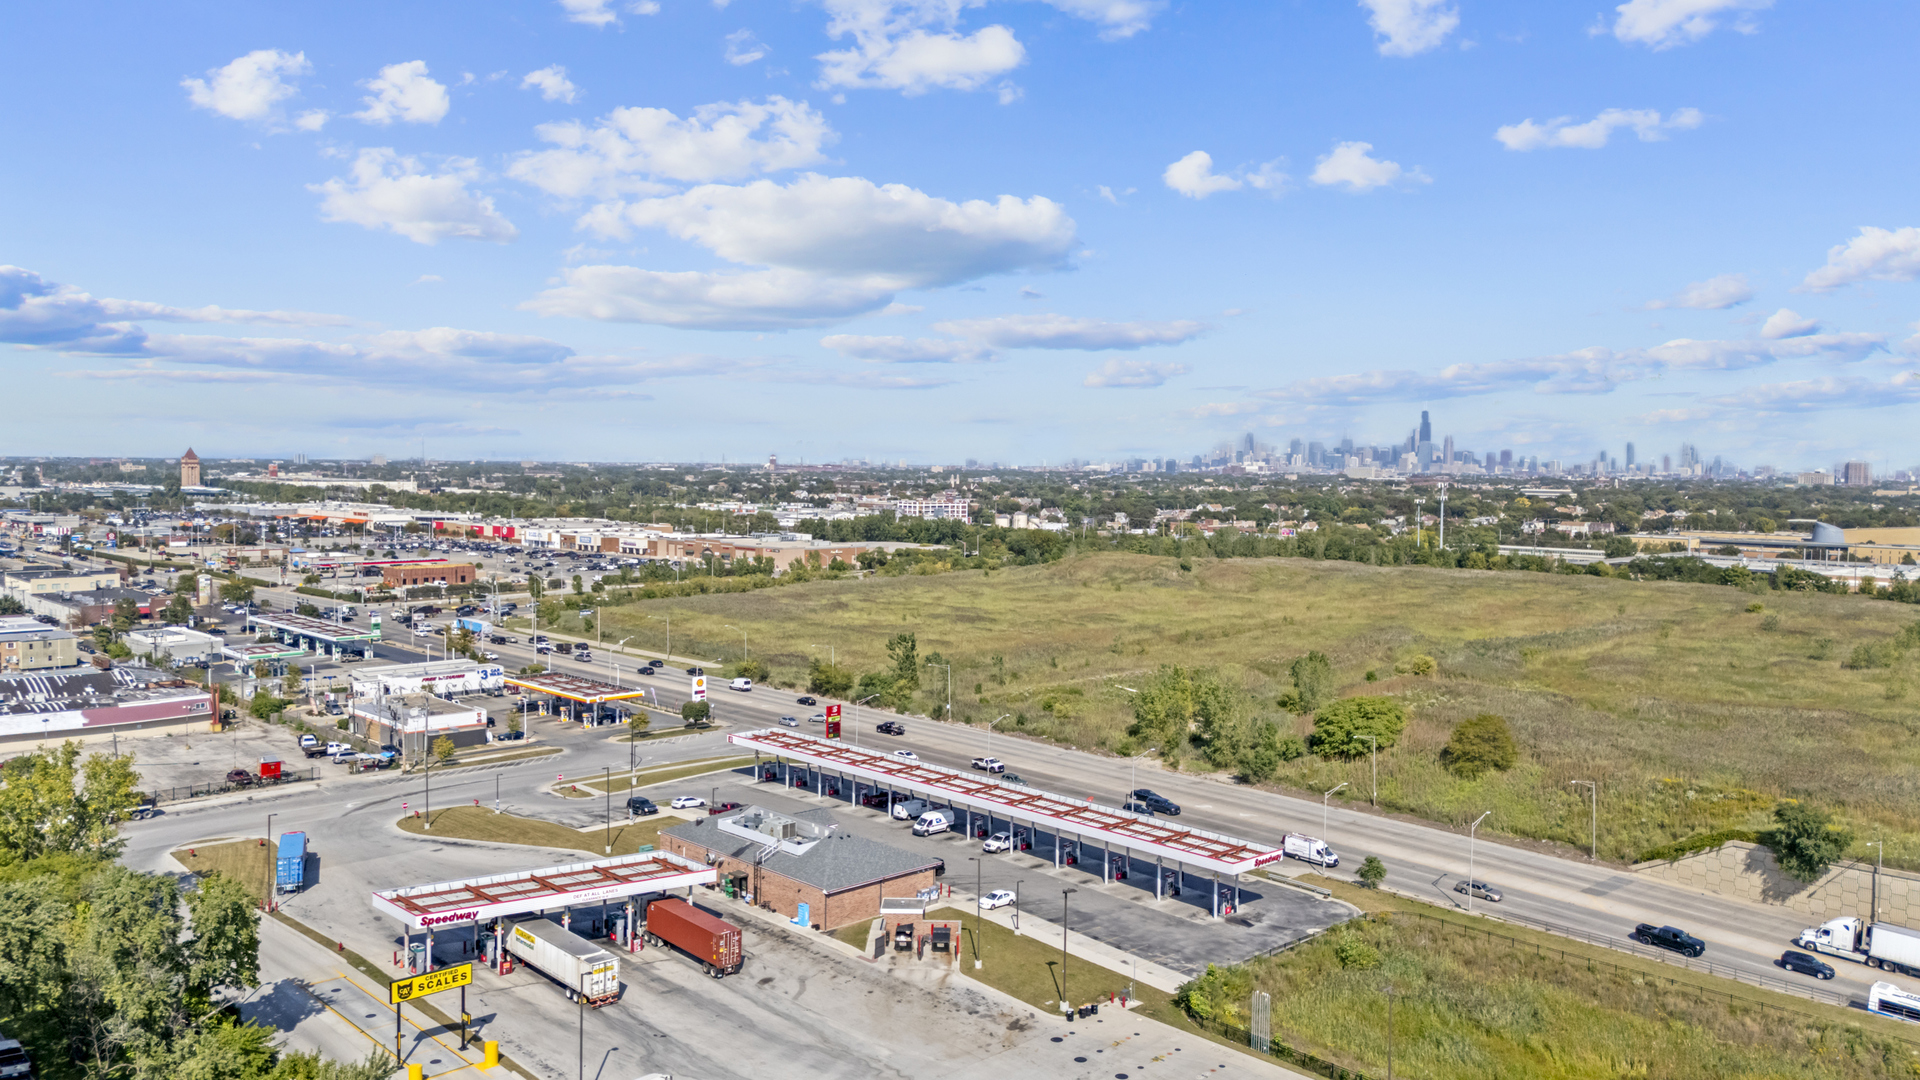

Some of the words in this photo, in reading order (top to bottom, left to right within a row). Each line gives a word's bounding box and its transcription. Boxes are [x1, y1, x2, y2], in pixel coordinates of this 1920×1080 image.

[1254, 853, 1283, 867] Speedway
[420, 910, 479, 927] Speedway
[418, 972, 468, 992] SCALES
[425, 969, 459, 981] CERTIFIED
[399, 987, 411, 995] CAT
